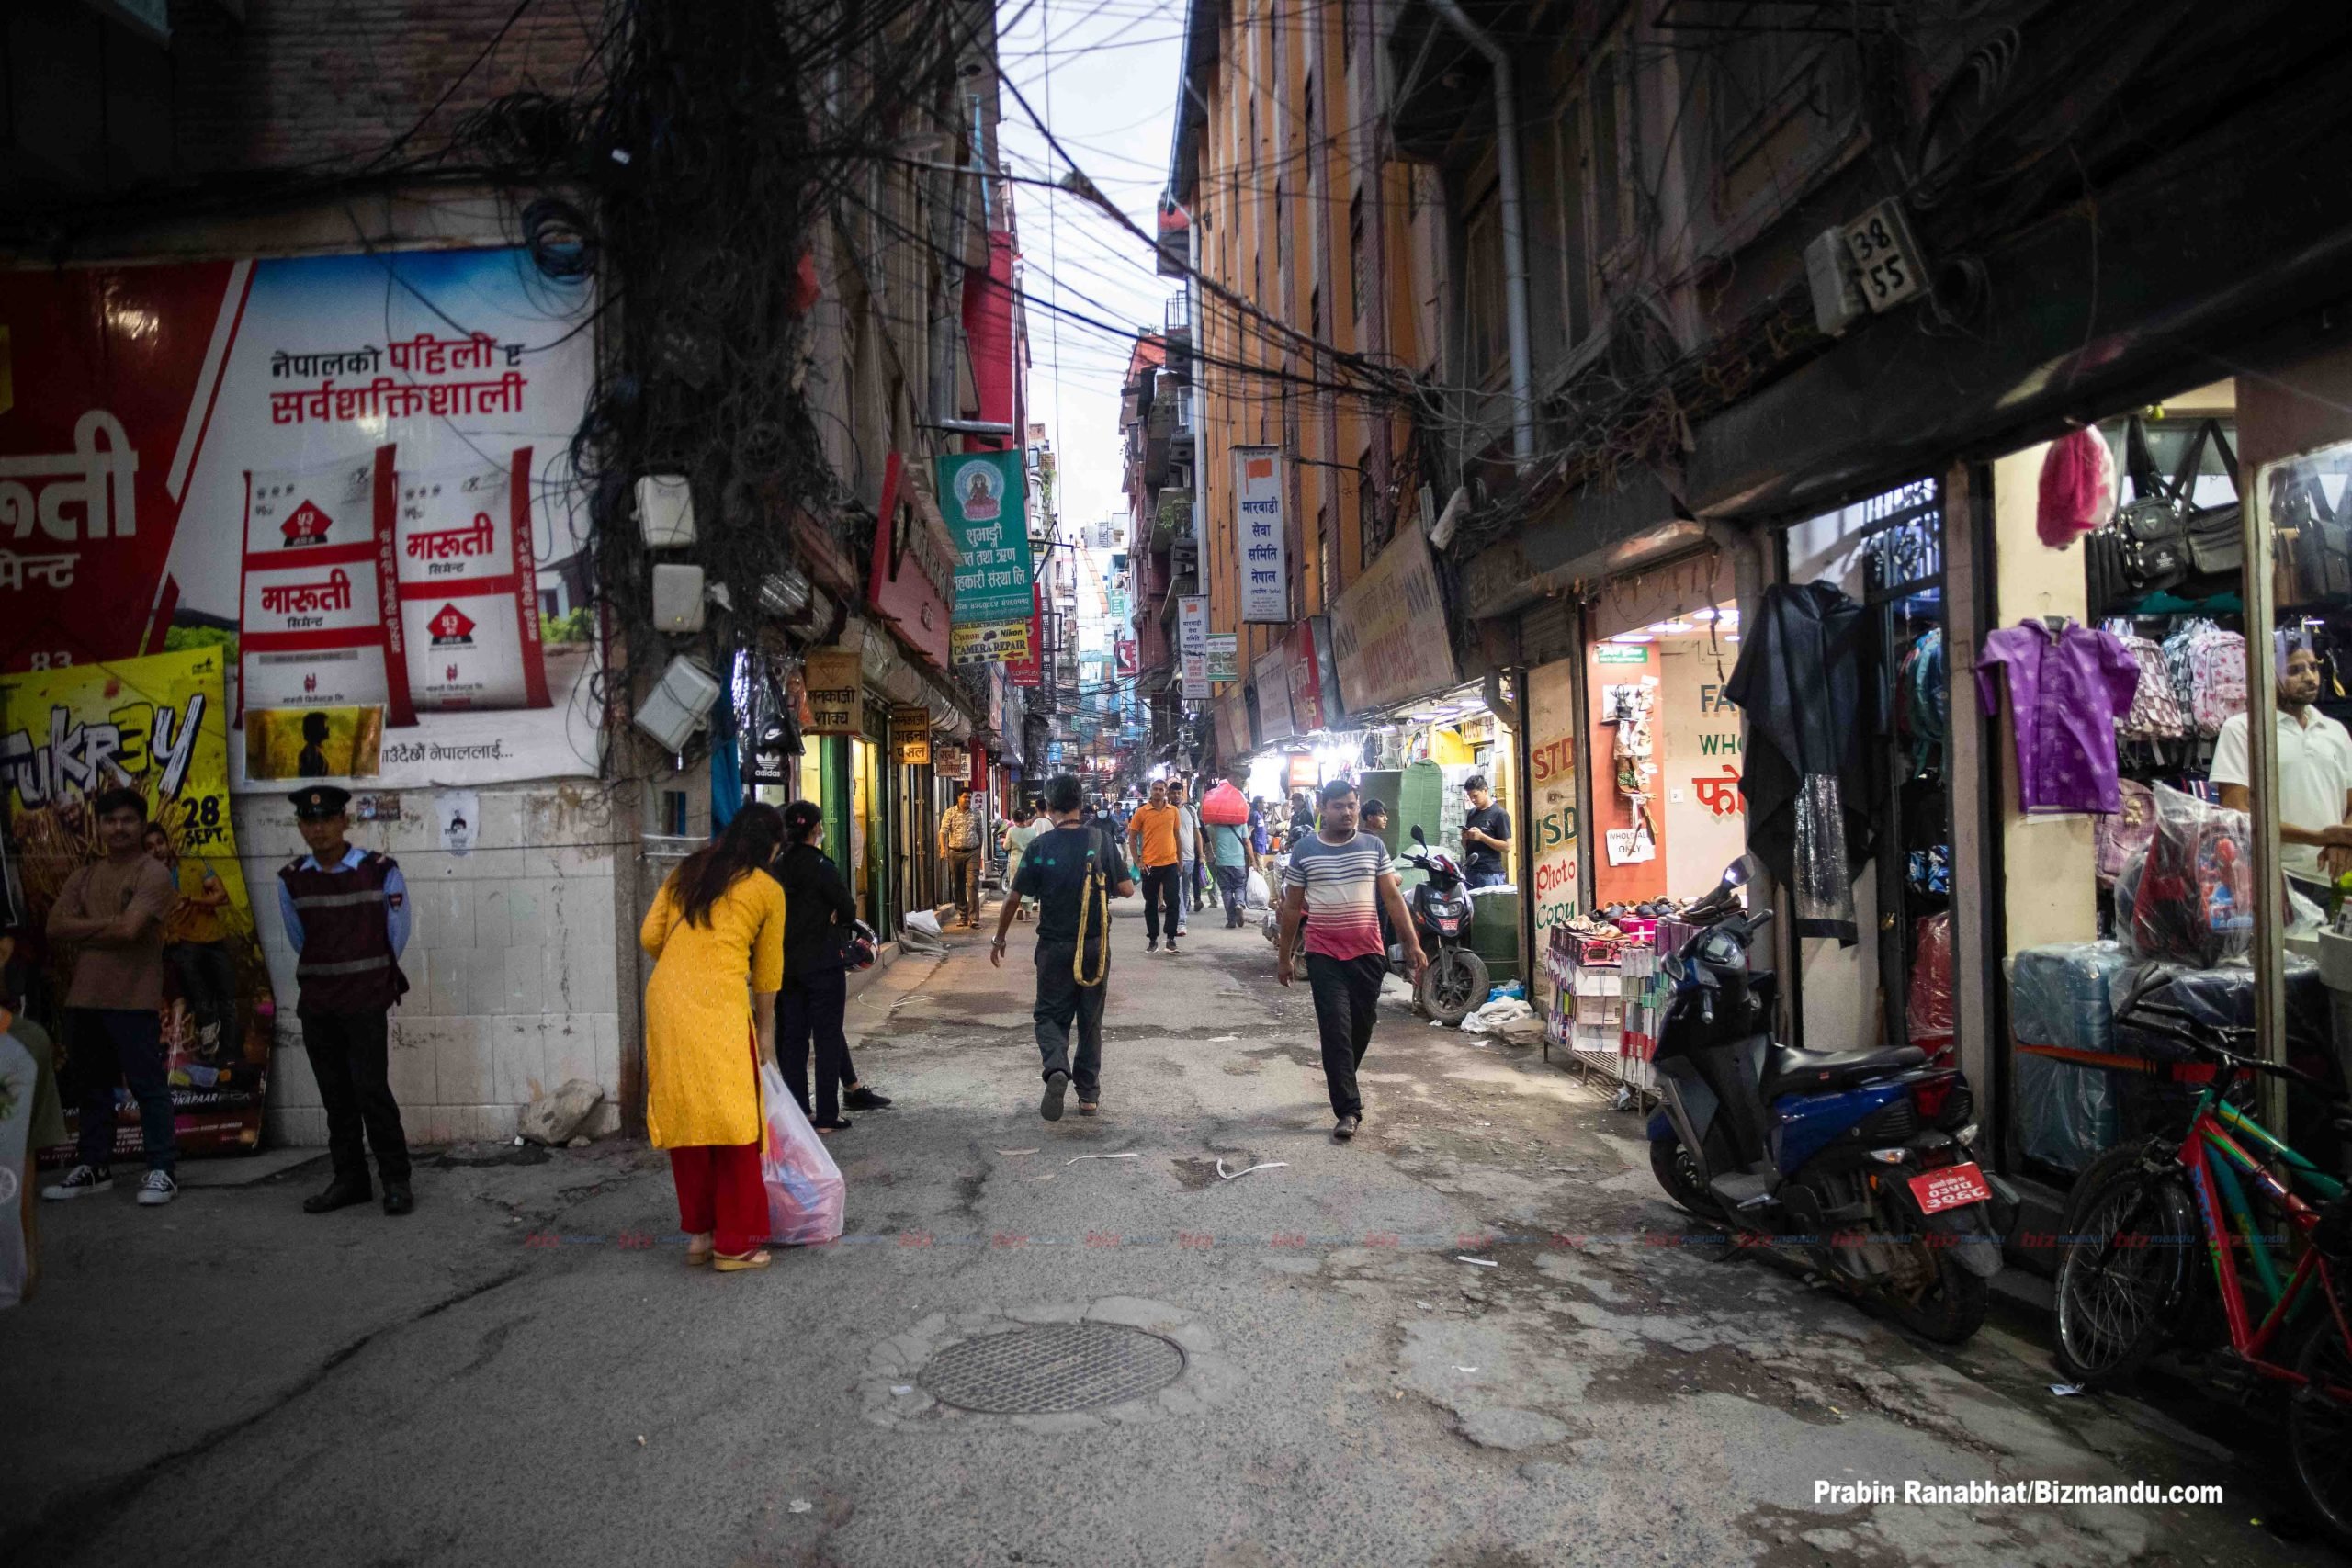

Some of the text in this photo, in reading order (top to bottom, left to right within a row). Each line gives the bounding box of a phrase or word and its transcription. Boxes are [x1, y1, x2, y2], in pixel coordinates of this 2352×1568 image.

[1854, 217, 1891, 260] 38
[271, 345, 382, 378] नेपालको
[269, 372, 528, 425] सर्वशक्तिशाली
[1242, 499, 1279, 514] मारवाडी
[1251, 522, 1272, 537] सेवा
[976, 549, 993, 567] तथा
[1248, 543, 1278, 561] समिति
[1251, 568, 1277, 584] नेपाल
[953, 628, 1023, 642] Canon Nikon
[954, 639, 1027, 656] CAMERA REPAIR
[1700, 683, 1736, 713] FA
[1698, 733, 1742, 756] WH
[1532, 737, 1575, 782] STD
[754, 769, 781, 778] adidas
[1535, 806, 1578, 854] ISD
[1535, 858, 1576, 901] Photo
